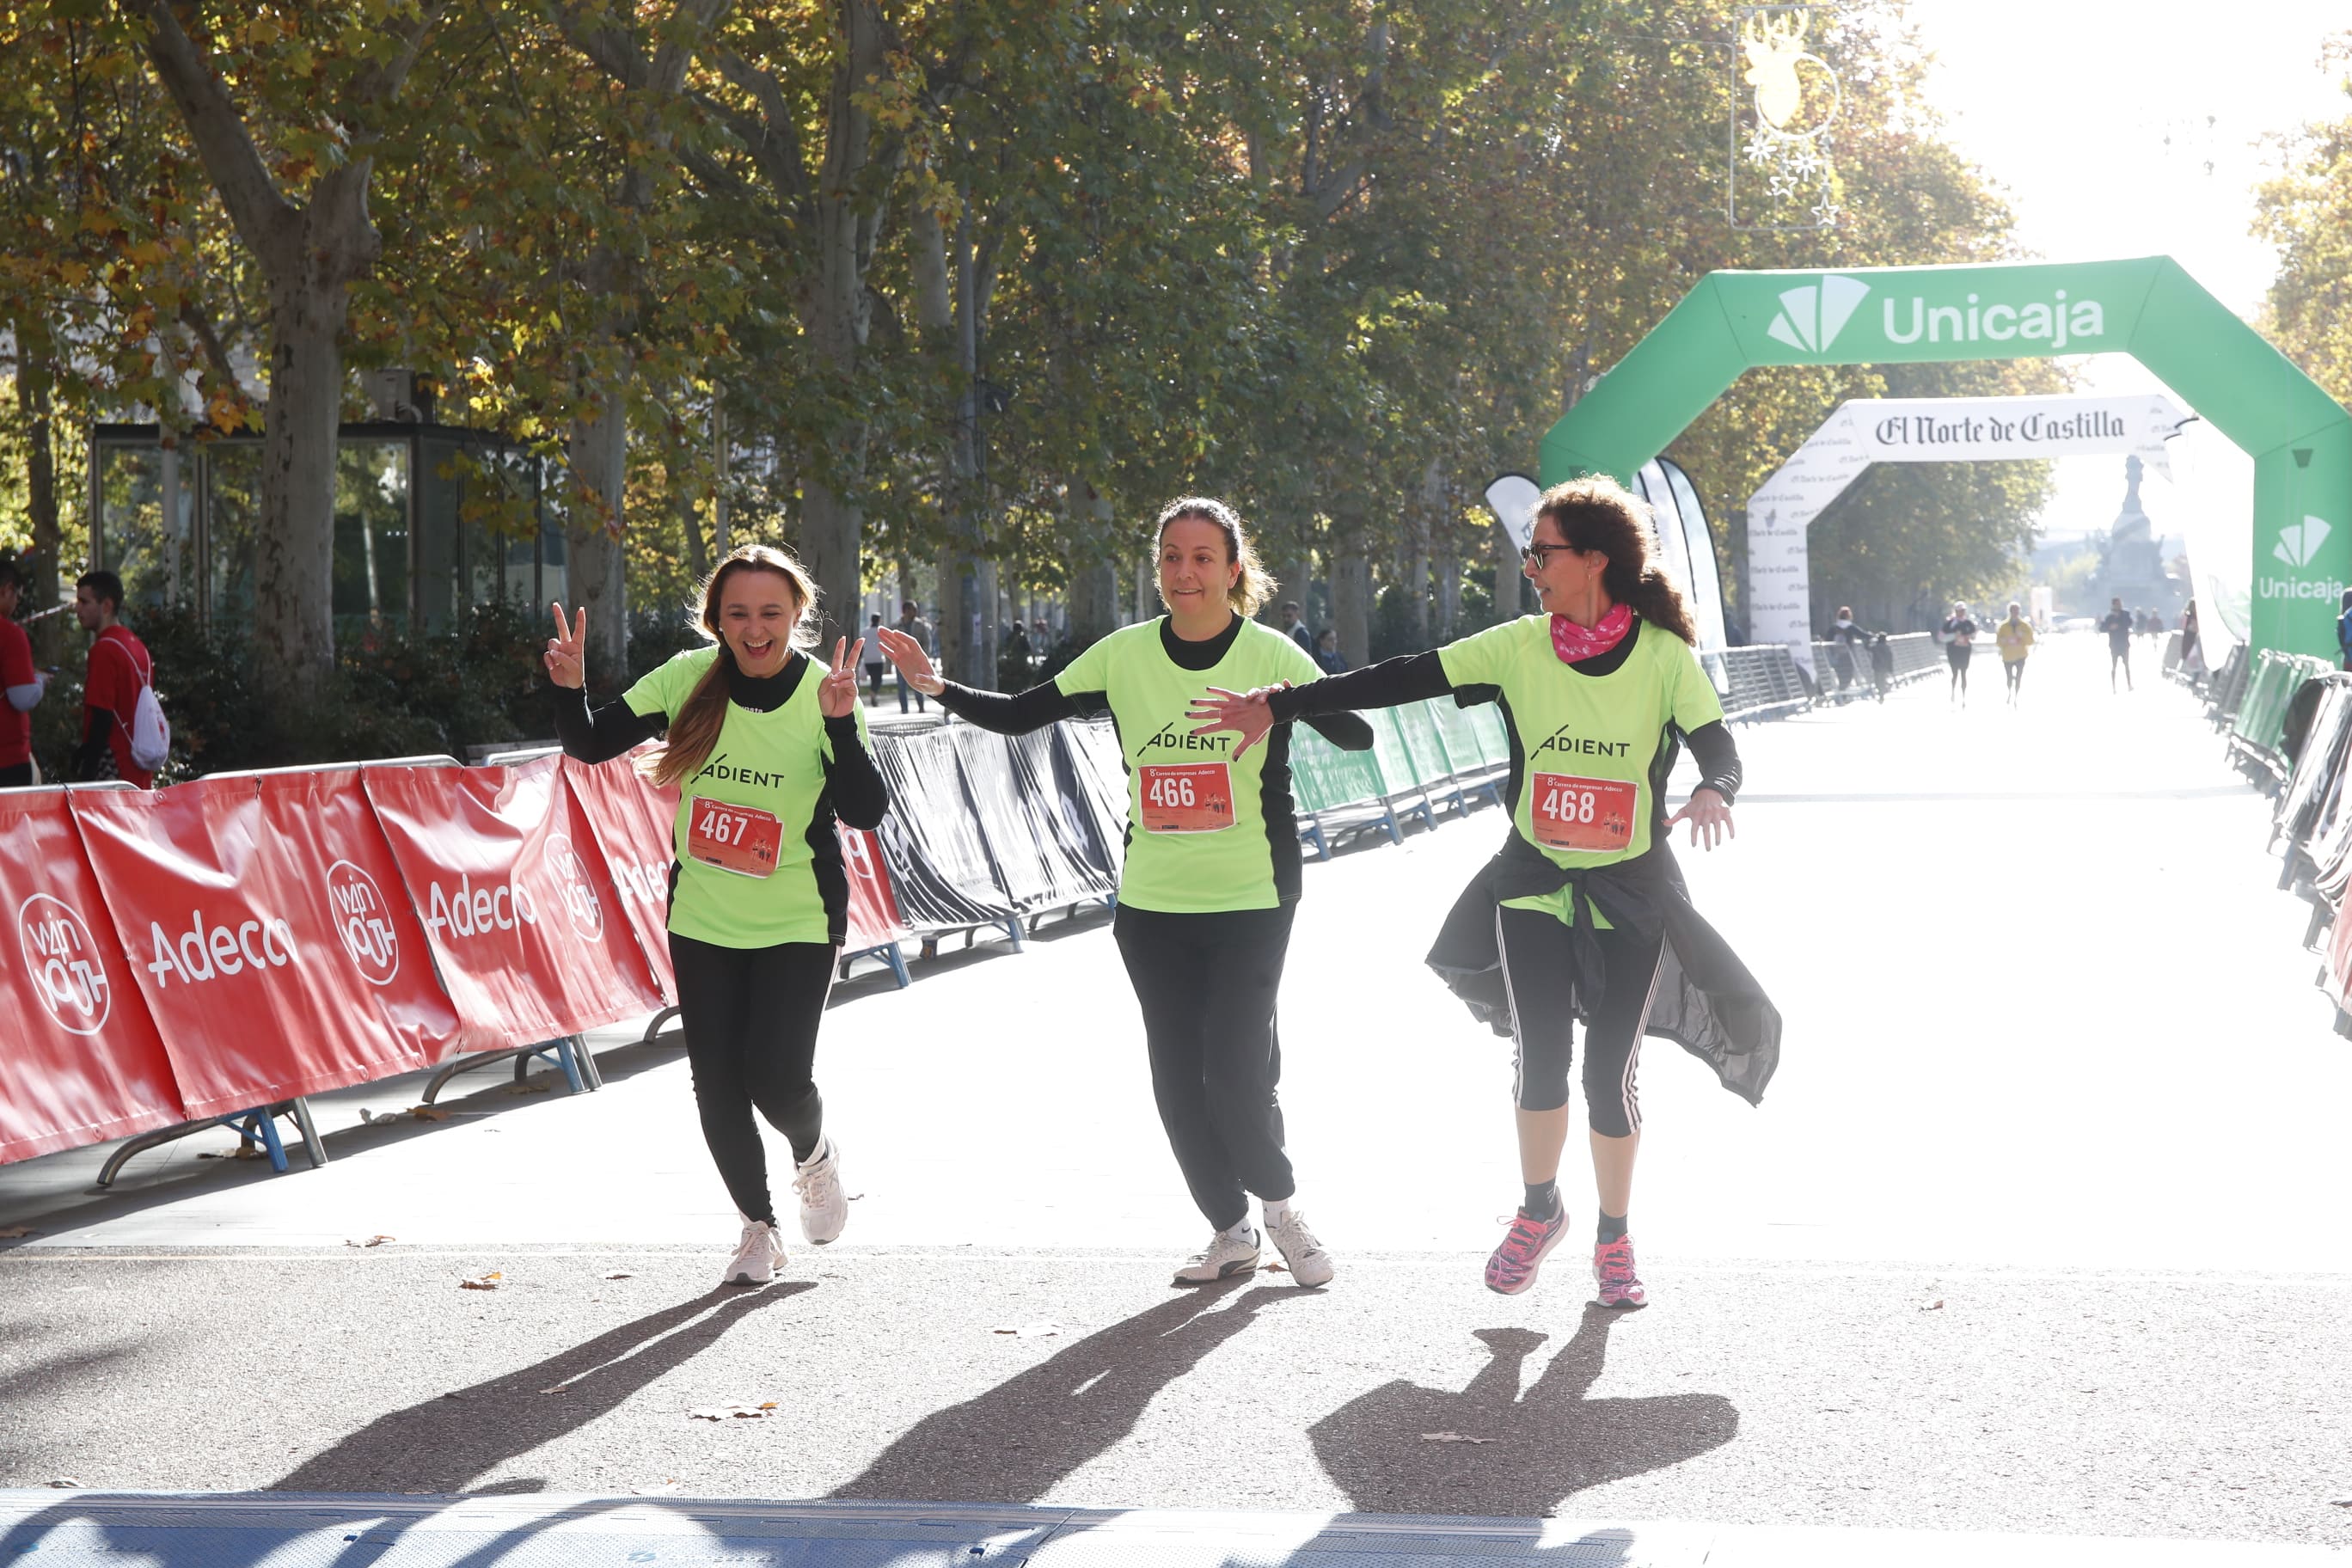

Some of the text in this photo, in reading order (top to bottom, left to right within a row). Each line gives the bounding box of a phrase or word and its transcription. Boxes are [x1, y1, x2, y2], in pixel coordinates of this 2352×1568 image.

[1883, 289, 2104, 348] Unicaja
[1876, 410, 2126, 445] El Norte de Castilla
[2259, 577, 2343, 605] Unicaja
[1142, 726, 1231, 753] ADIENT
[1534, 730, 1631, 758] ADIENT
[694, 758, 785, 788] ADIENT
[1149, 778, 1196, 807] 466
[1541, 788, 1596, 824] 468
[699, 811, 748, 846] 467
